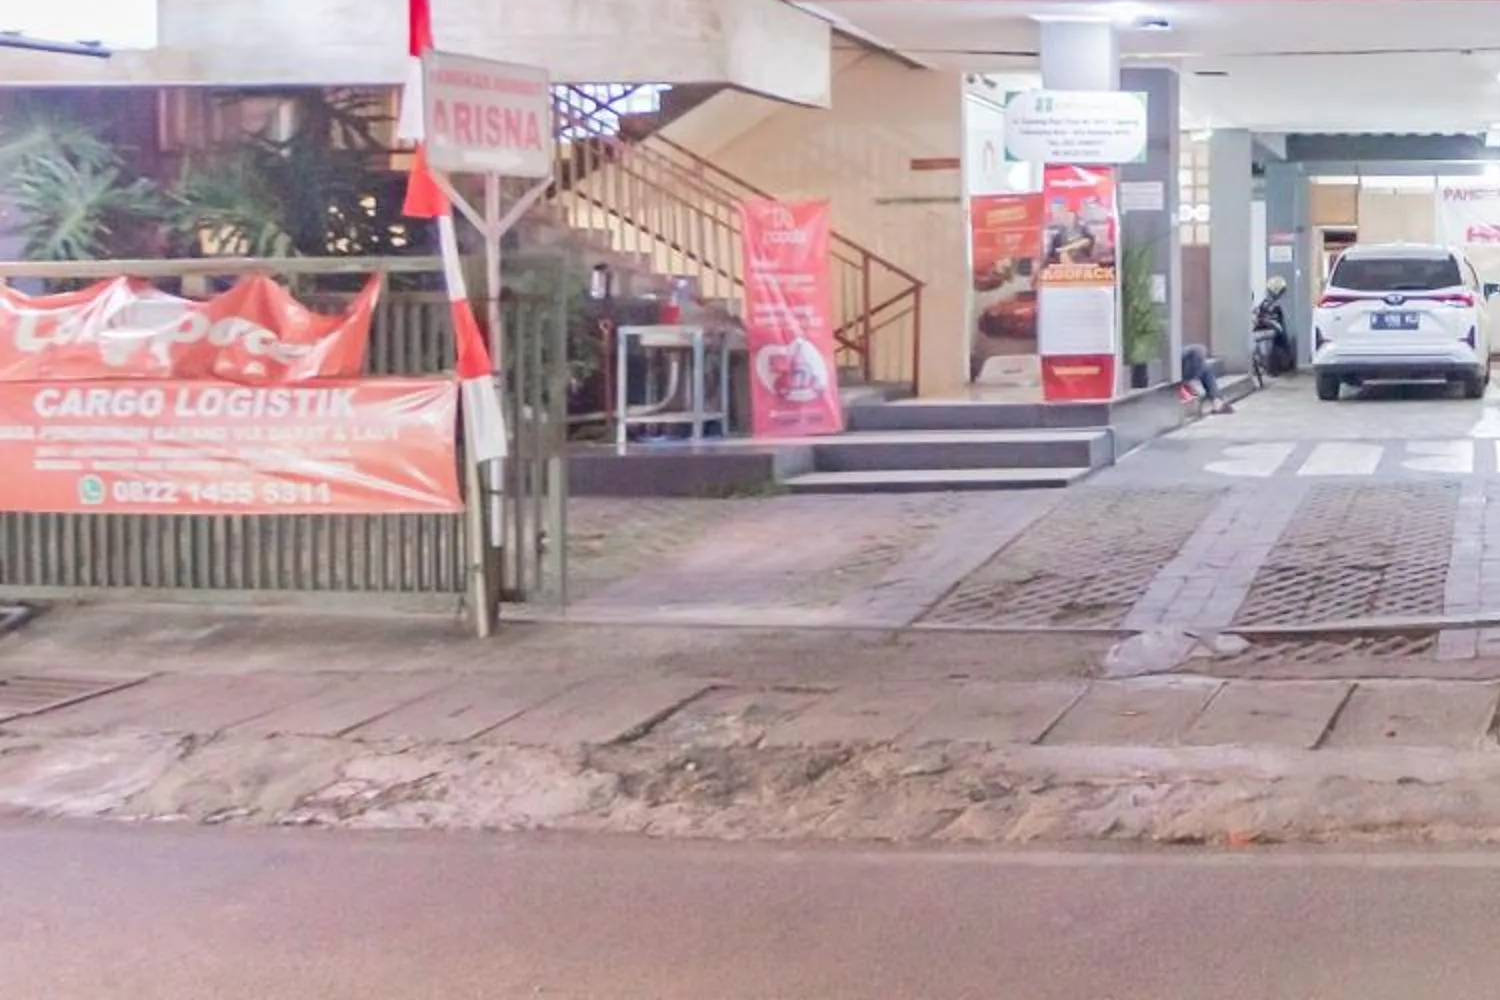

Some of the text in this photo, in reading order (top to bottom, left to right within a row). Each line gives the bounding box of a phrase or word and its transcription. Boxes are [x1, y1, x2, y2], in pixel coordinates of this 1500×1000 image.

[432, 99, 543, 151] ARISNA
[34, 387, 358, 418] CARGO LOGISTIK
[112, 481, 180, 504] 0822
